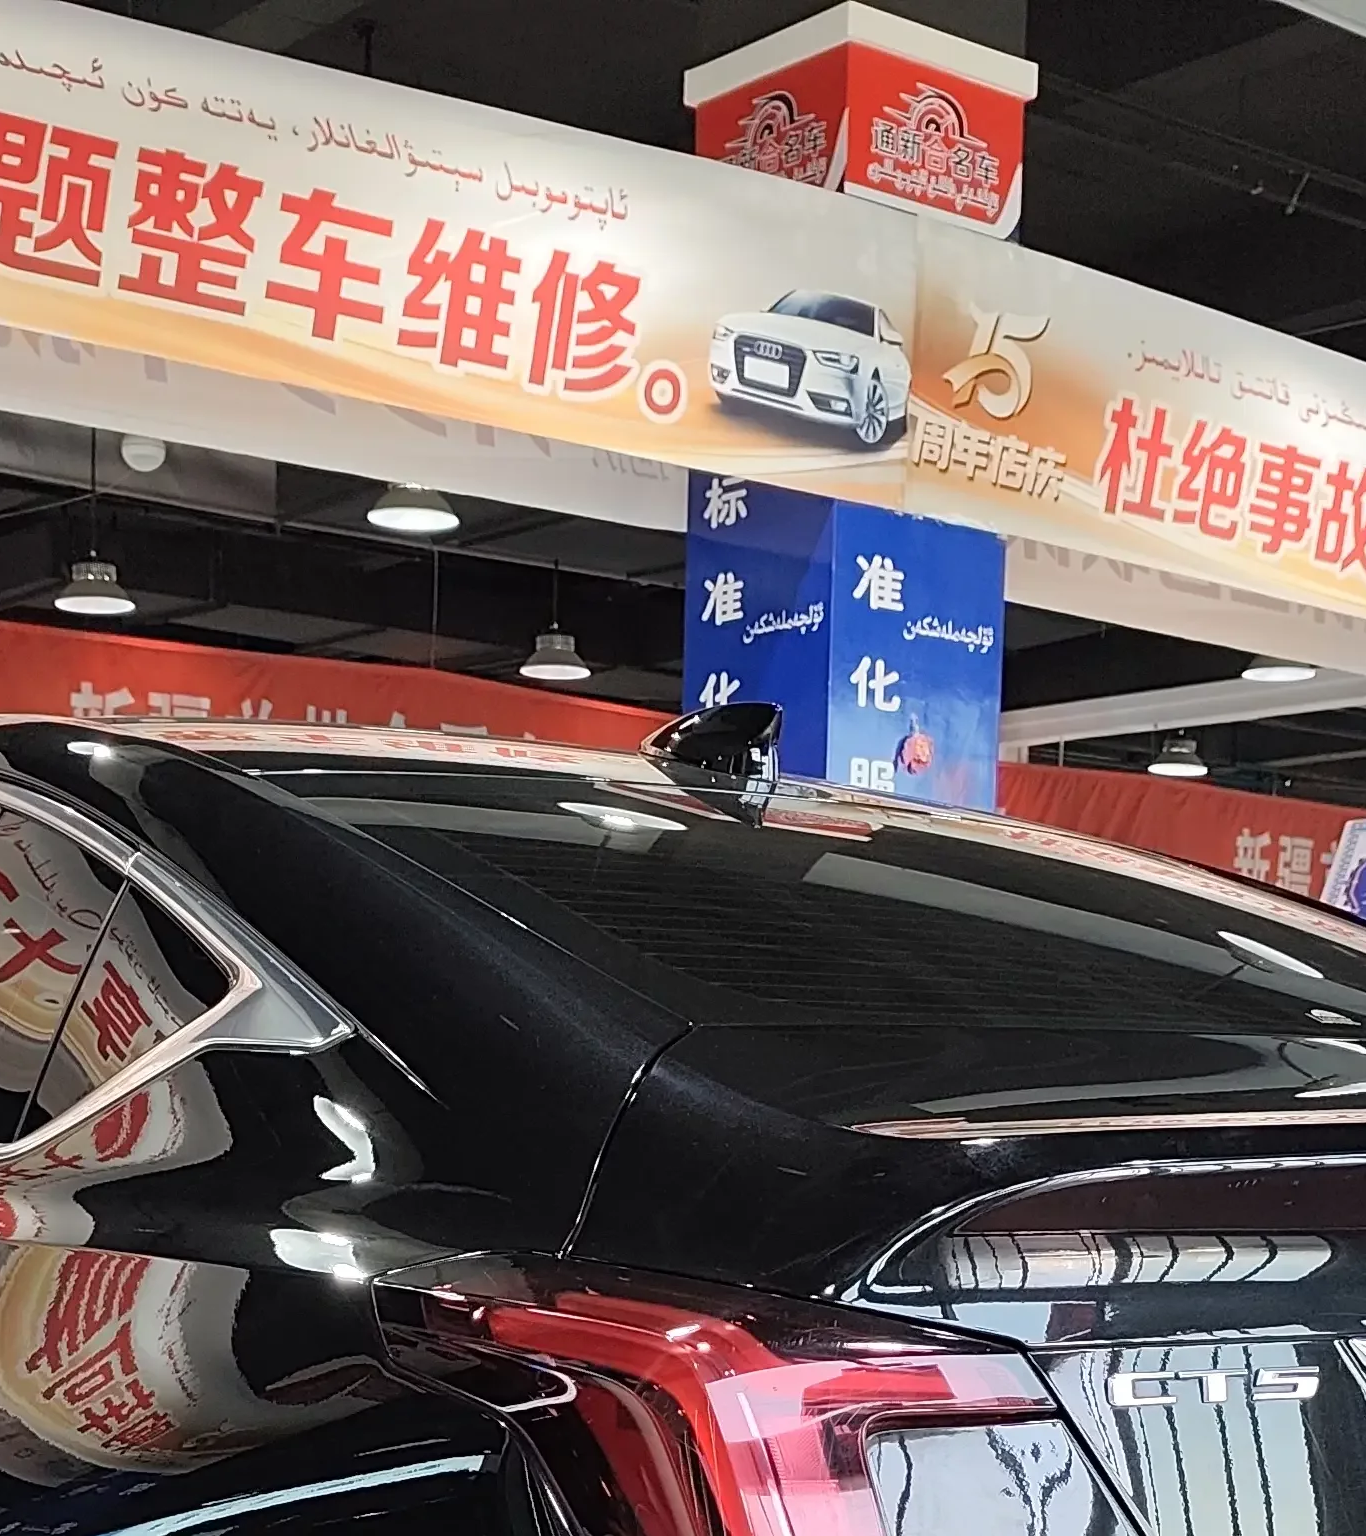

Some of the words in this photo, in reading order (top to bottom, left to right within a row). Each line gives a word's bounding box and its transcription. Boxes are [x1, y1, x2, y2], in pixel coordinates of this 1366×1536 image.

[870, 116, 1001, 188] 通新合名车
[1107, 1366, 1319, 1406] CT5
